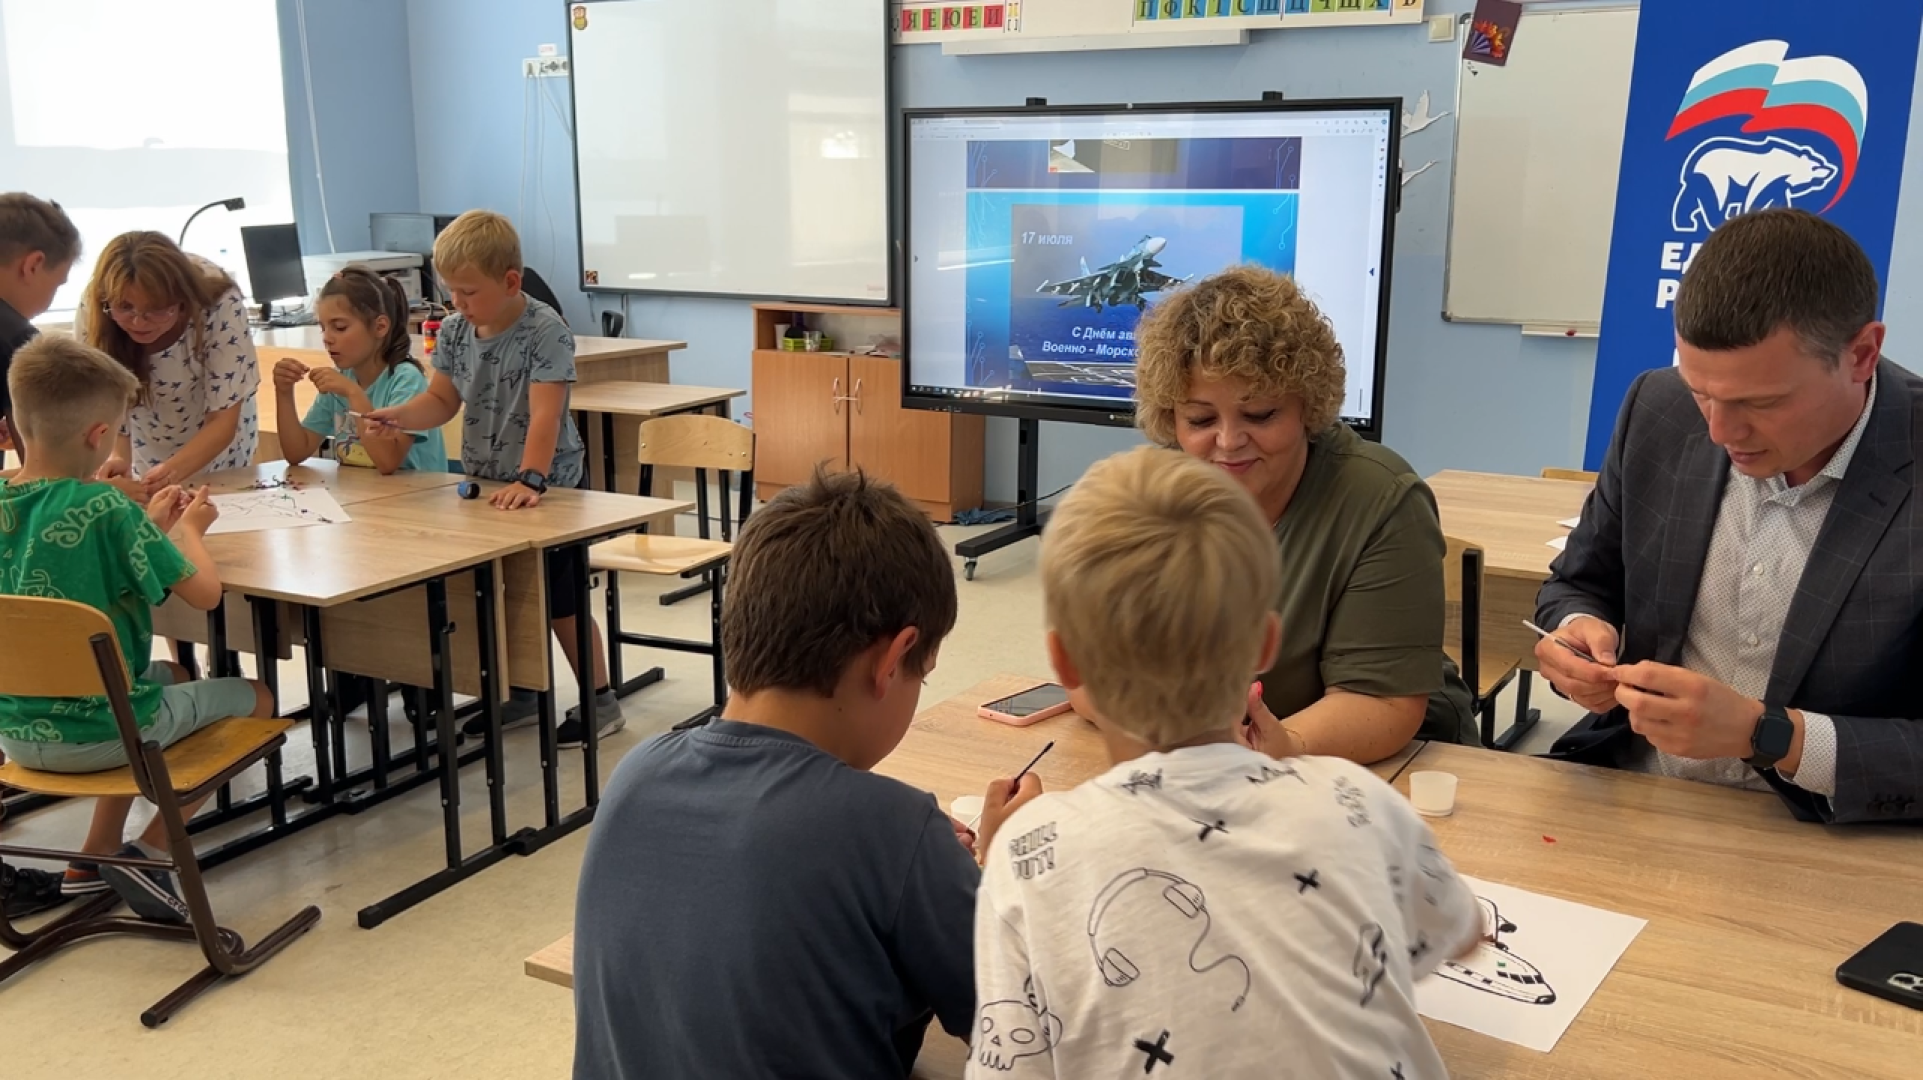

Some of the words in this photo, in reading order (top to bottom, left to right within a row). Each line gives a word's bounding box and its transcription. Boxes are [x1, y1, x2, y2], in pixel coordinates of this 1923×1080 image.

[1021, 231, 1036, 245] 17
[1038, 234, 1073, 245] июля
[1072, 326, 1081, 338] С
[1083, 327, 1115, 340] Днём
[1118, 330, 1135, 340] ав
[1042, 340, 1086, 354] Военно
